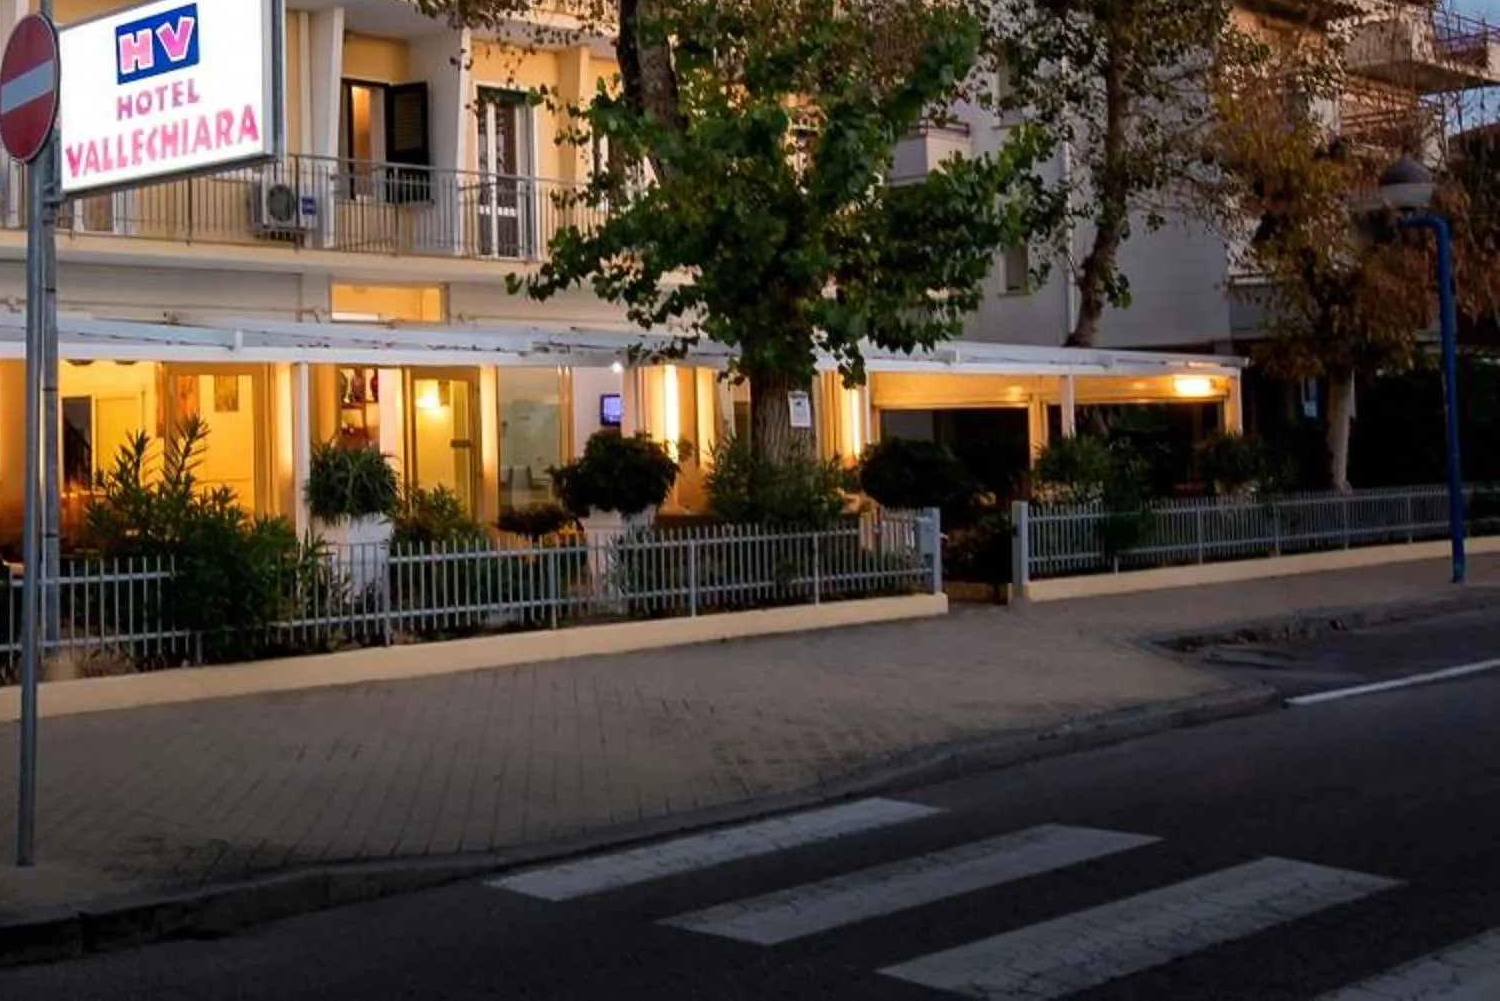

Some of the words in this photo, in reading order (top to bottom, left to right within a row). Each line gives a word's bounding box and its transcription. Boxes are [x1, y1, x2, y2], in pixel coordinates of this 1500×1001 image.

[118, 16, 195, 74] HV
[116, 78, 200, 121] HOTEL
[65, 104, 260, 178] VALLECHIARA
